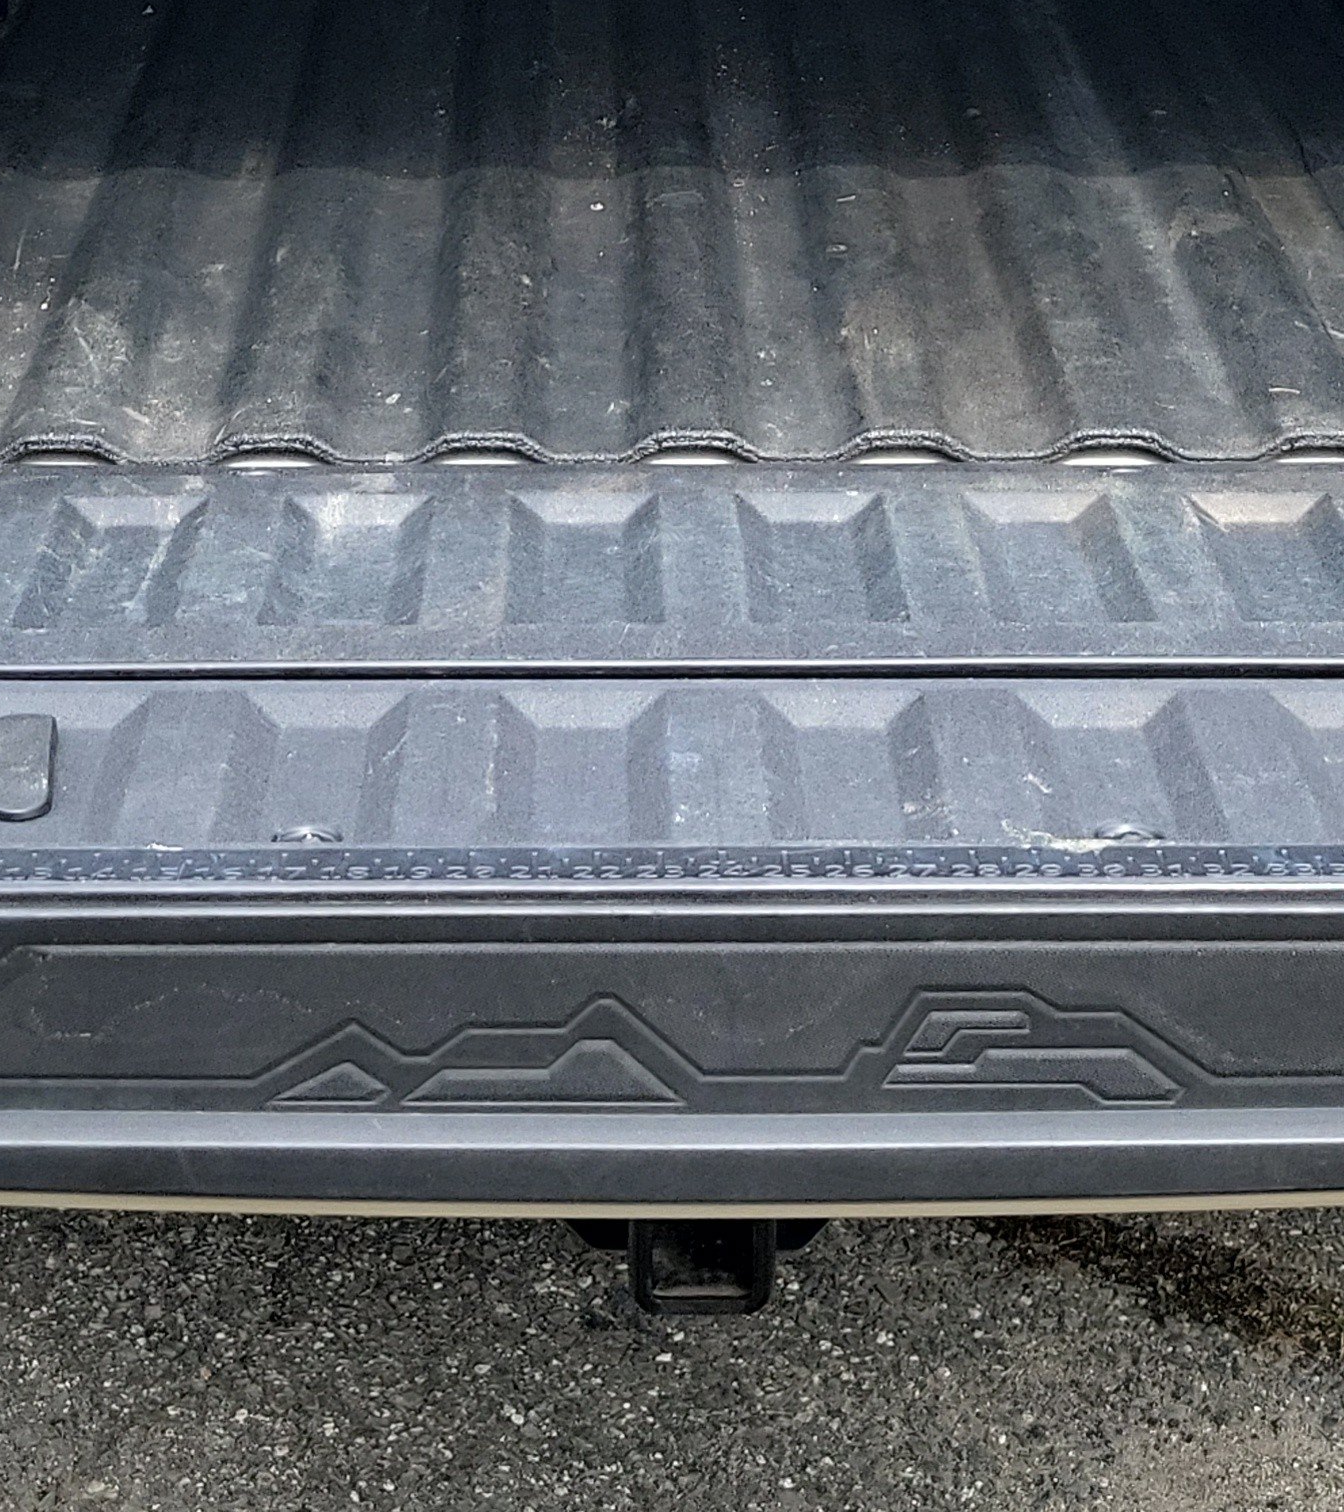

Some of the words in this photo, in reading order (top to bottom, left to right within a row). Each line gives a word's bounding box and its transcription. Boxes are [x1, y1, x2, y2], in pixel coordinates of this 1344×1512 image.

[256, 866, 306, 881] 17
[321, 866, 369, 879] 18
[383, 866, 432, 879] 19
[446, 865, 495, 879] 20
[510, 865, 558, 879] 21
[573, 865, 622, 879] 22
[637, 865, 685, 879] 23
[699, 864, 750, 878] 24
[763, 864, 812, 878] 25
[826, 864, 874, 878] 26
[888, 864, 937, 878] 27
[951, 864, 1001, 877] 28
[1014, 864, 1062, 877] 29
[1077, 863, 1125, 877] 30
[1140, 863, 1189, 877] 31
[1203, 863, 1254, 876] 32
[1267, 863, 1314, 876] 33
